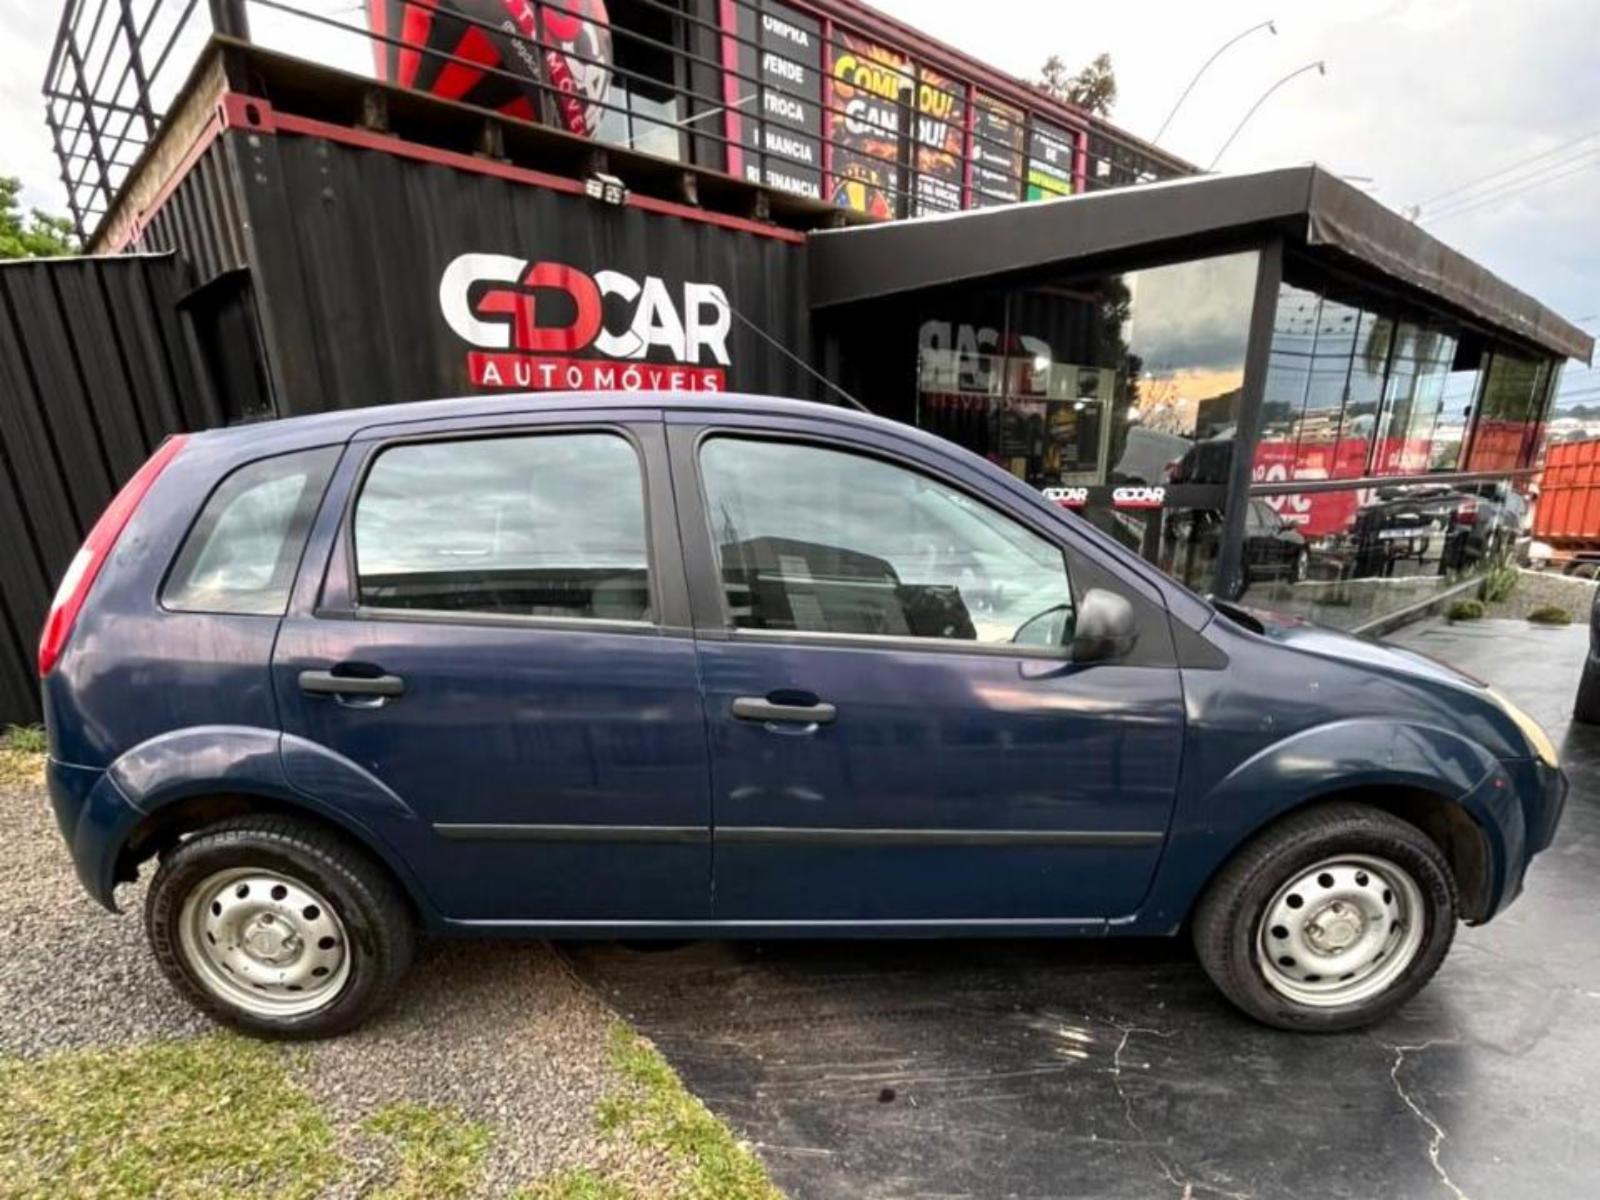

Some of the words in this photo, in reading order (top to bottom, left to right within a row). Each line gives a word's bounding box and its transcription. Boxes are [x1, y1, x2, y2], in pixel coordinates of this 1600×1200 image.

[762, 14, 809, 47] OMPRA
[834, 55, 954, 119] COMOU!
[754, 128, 812, 162] NANCIA
[747, 164, 820, 199] RINANCIA
[439, 253, 732, 367] GDCAR
[482, 361, 719, 393] AUTOMÓVEIS
